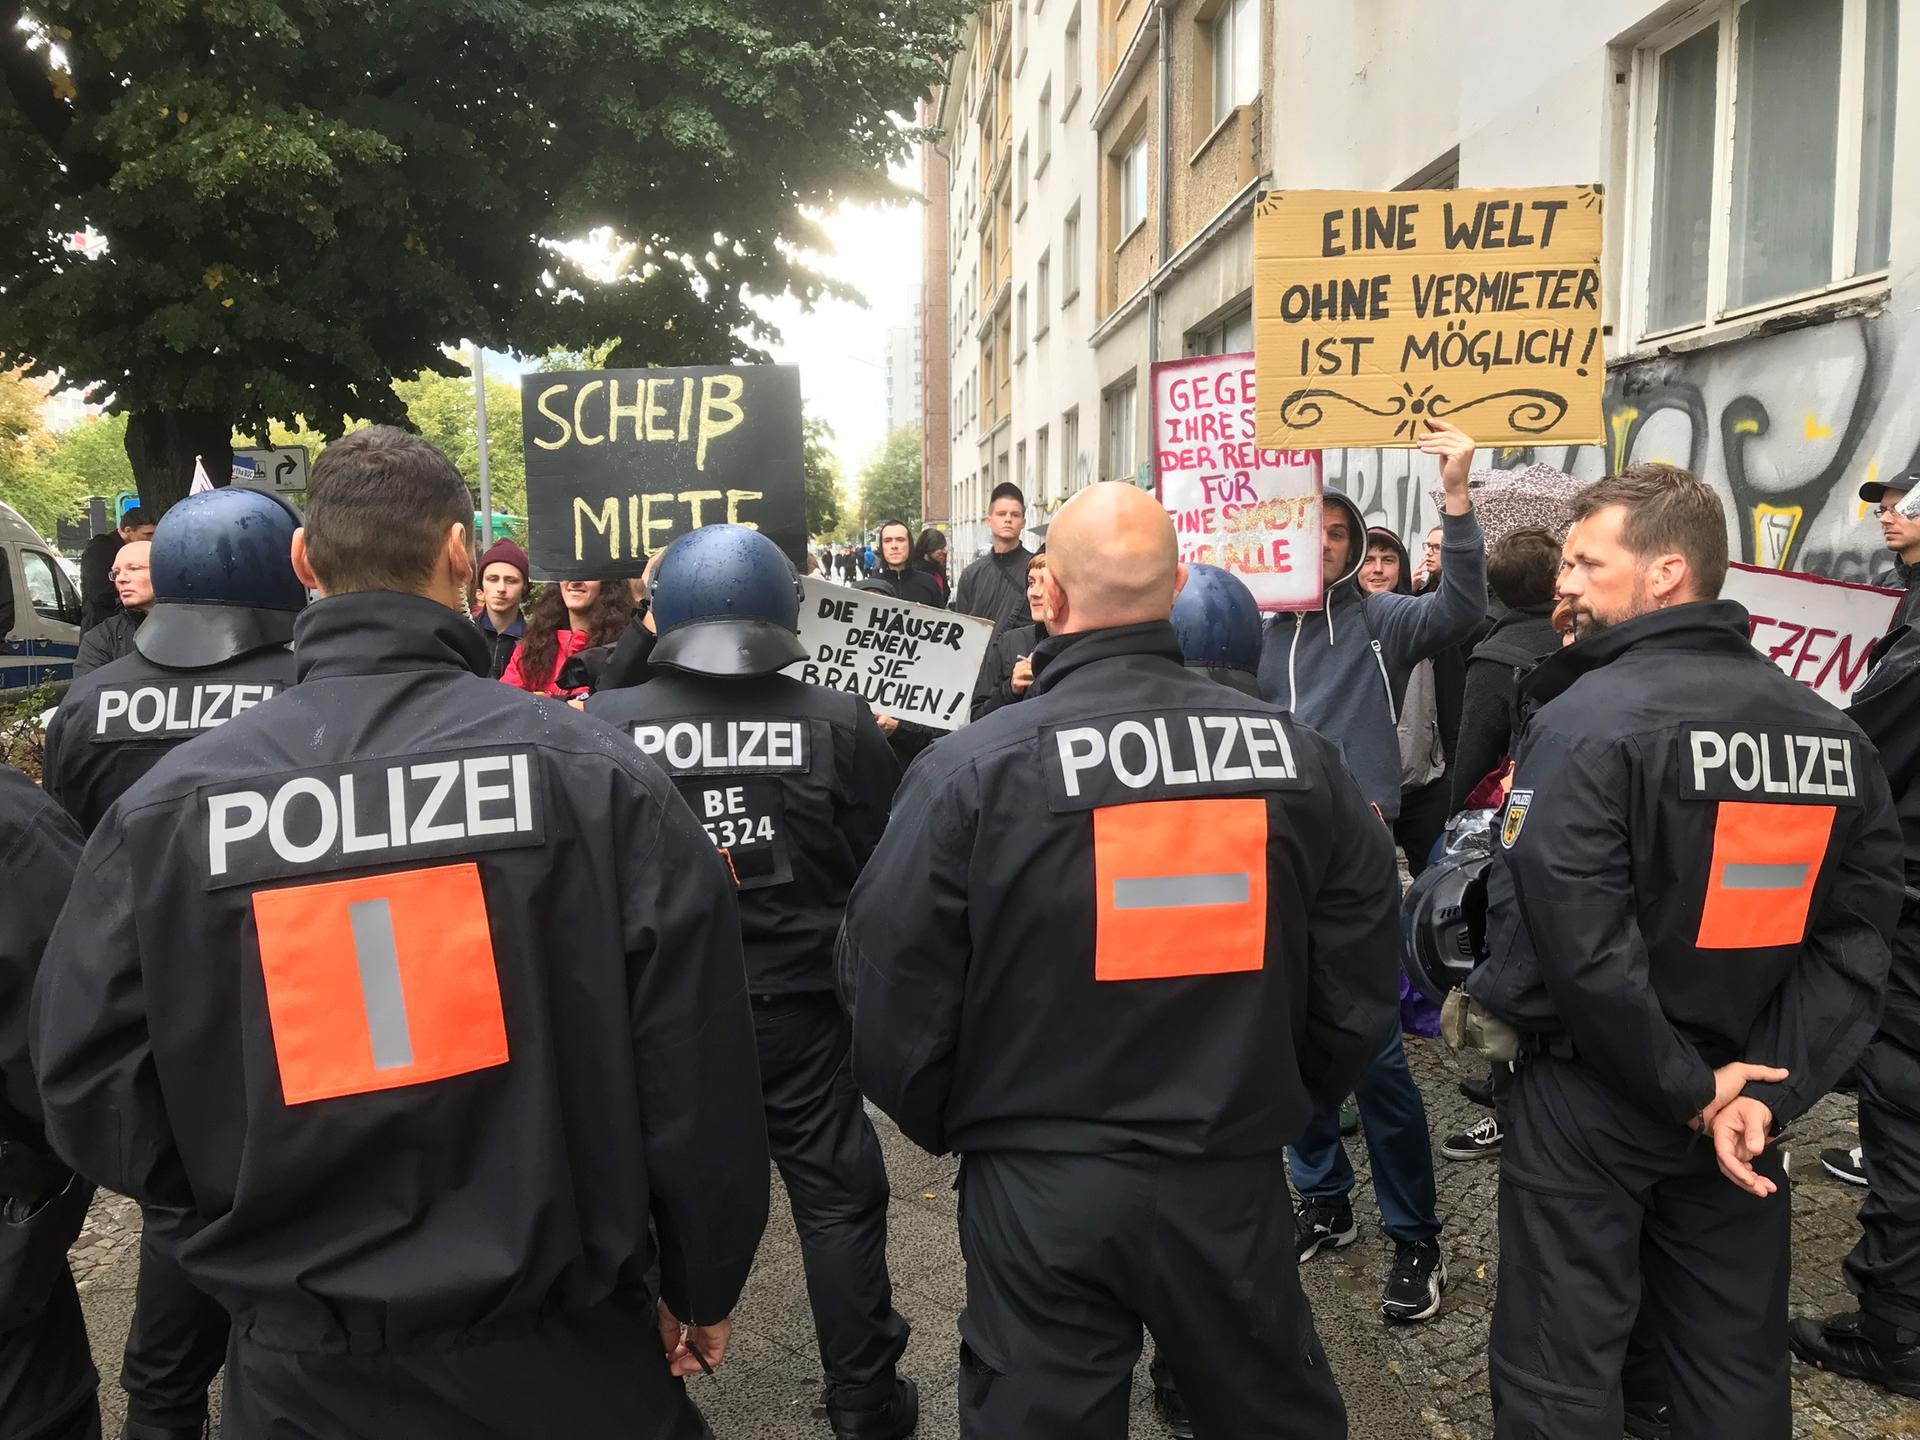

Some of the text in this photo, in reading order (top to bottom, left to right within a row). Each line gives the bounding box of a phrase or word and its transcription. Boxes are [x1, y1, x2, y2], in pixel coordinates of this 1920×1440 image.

[1322, 200, 1568, 257] EINE WELT
[1280, 268, 1599, 323] OHNE VERMIETER
[1301, 337, 1375, 376] IST
[1165, 408, 1256, 443] IHRE S
[1159, 447, 1217, 472] DER
[1200, 471, 1258, 504] FÜR
[1223, 539, 1293, 574] ALLE
[818, 598, 964, 651] DIE HÄUSER
[817, 644, 915, 679] DIE SIE
[845, 628, 921, 661] DENEN,
[634, 721, 802, 769] POLIZEI
[1056, 716, 1297, 797] POLIZEI
[1690, 730, 1856, 797] POLIZEI
[207, 754, 533, 876] POLIZEI
[703, 786, 746, 818] BE
[702, 816, 775, 848] 5324
